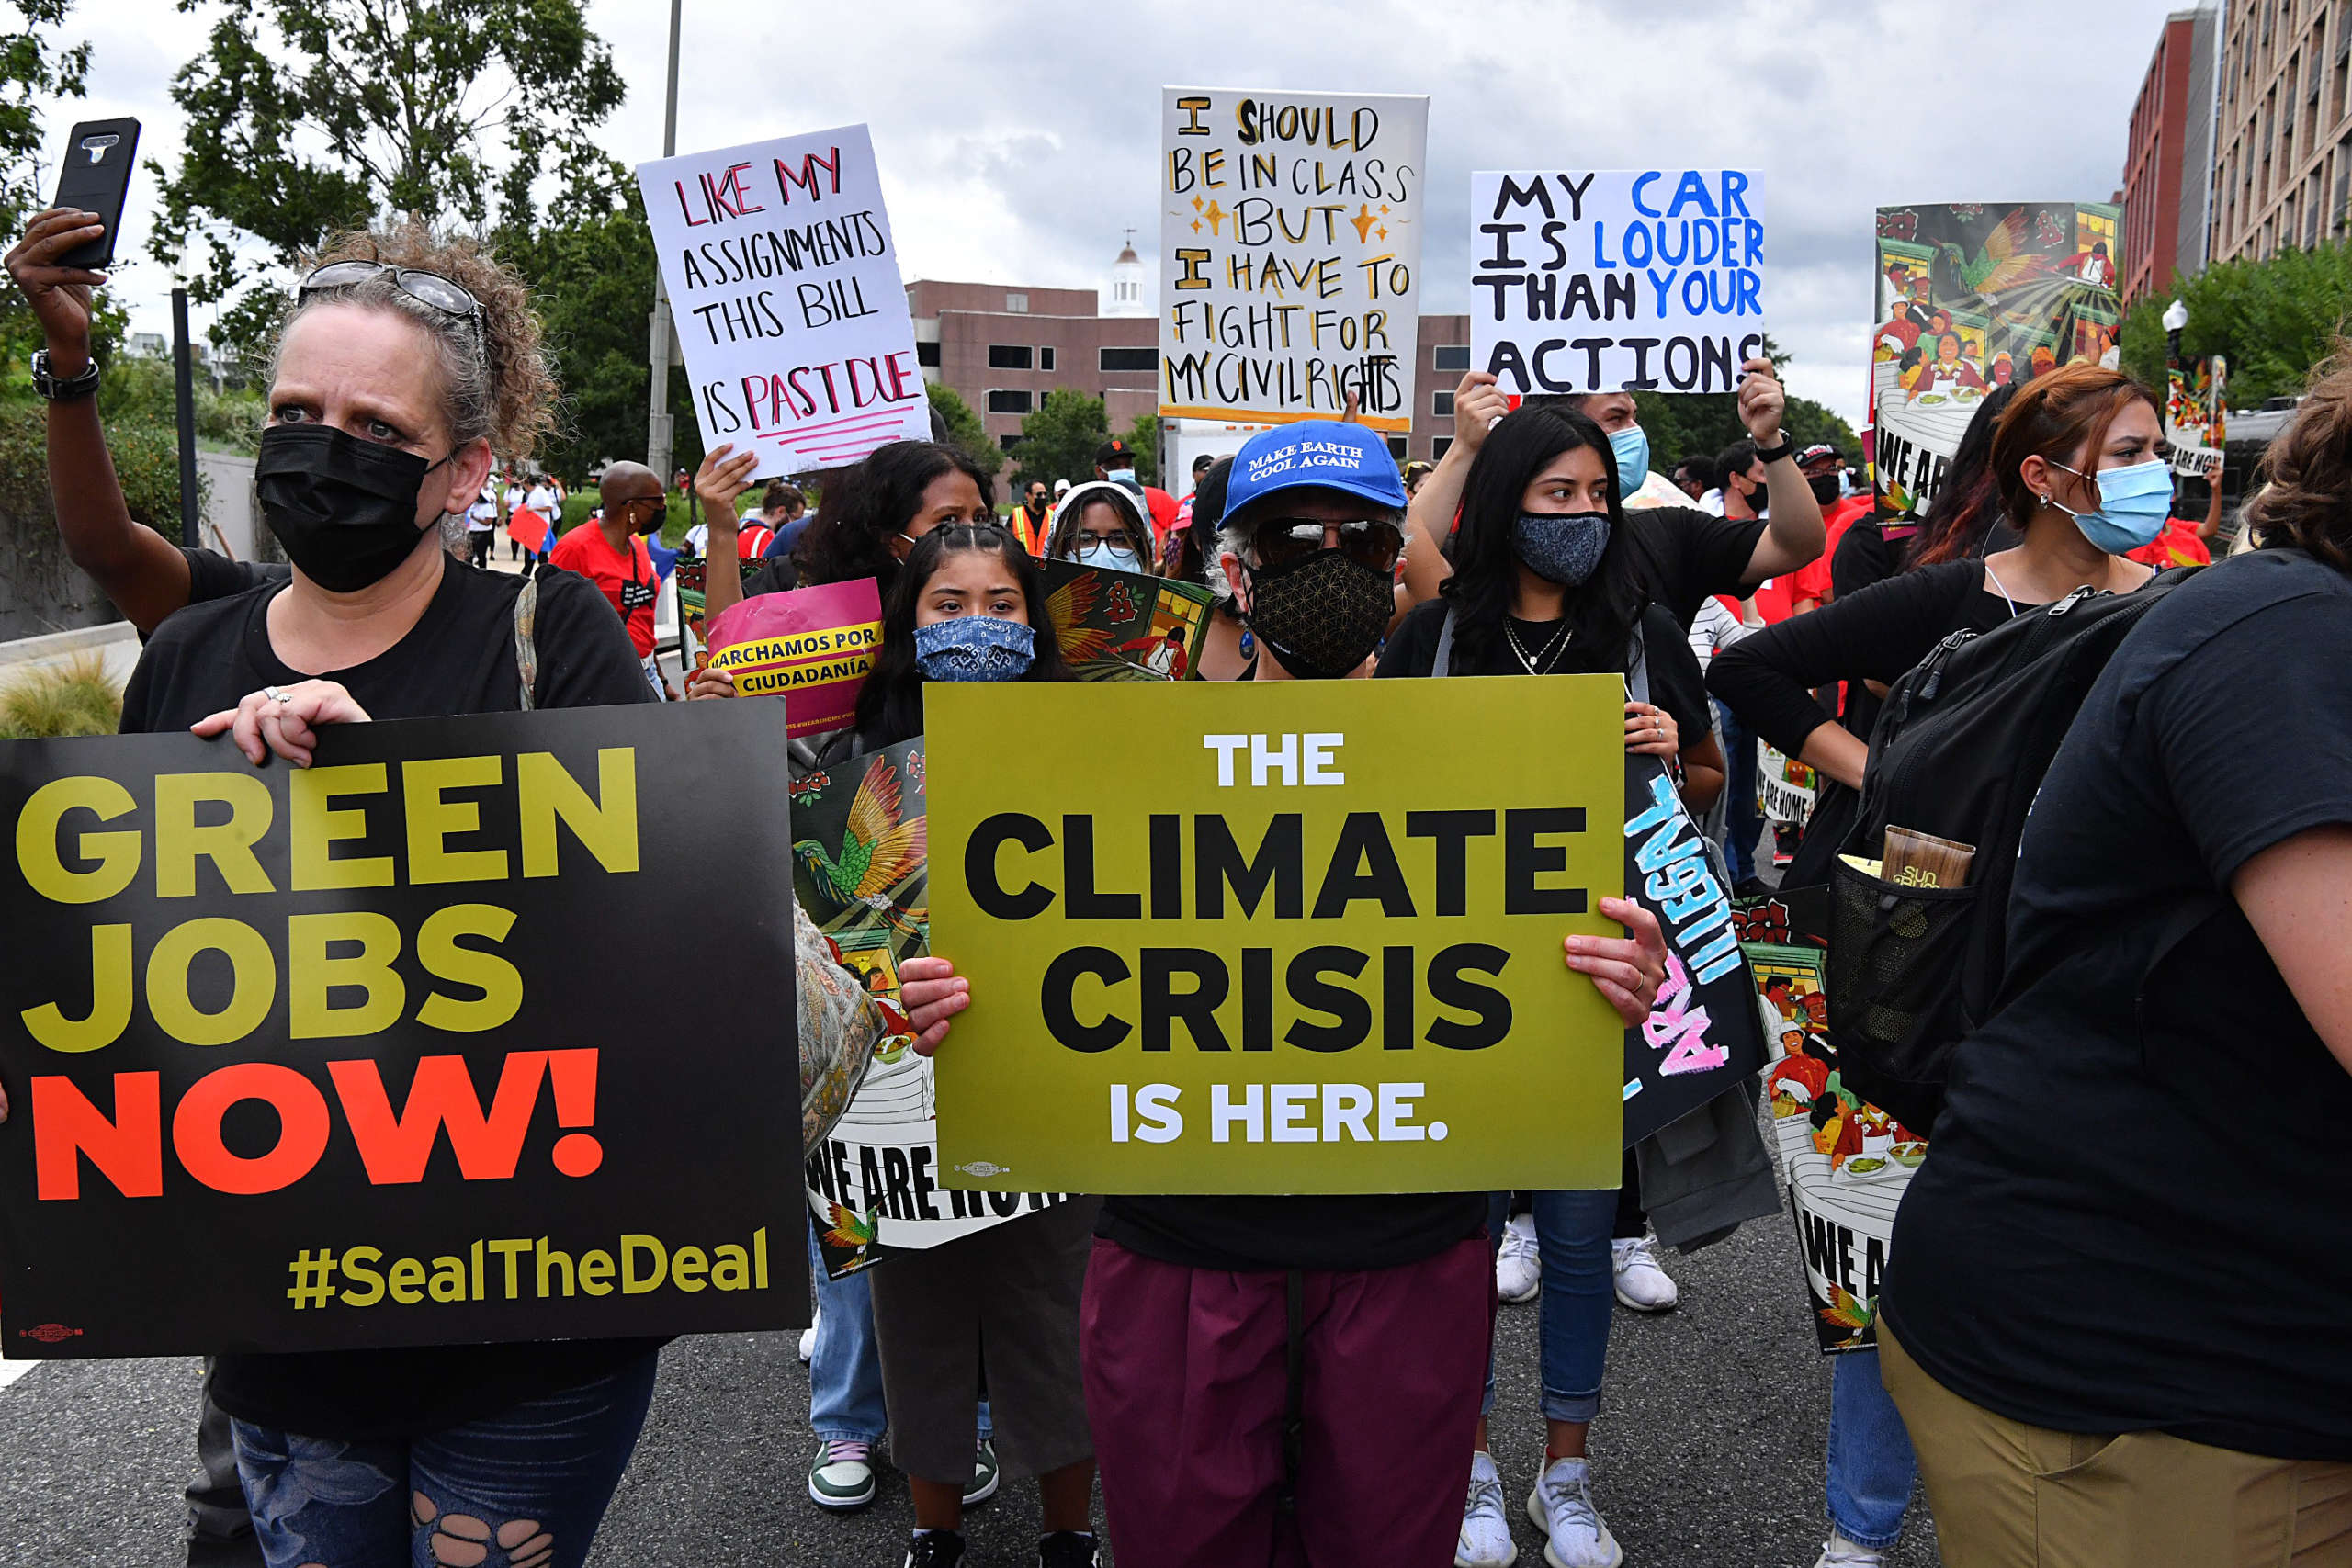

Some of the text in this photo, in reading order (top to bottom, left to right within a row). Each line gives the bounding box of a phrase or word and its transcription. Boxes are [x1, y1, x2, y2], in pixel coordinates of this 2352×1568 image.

[1177, 96, 1378, 152] I SHOULD
[674, 146, 841, 227] LIKE MY
[1169, 147, 1415, 203] BE IN CLASS
[1493, 170, 1750, 221] MY CAR
[683, 211, 885, 289] ASSIGNMENTS
[1233, 197, 1347, 246] BUT
[1480, 217, 1764, 271] IS LOUDER
[1174, 248, 1410, 299] I HAVE TO
[1472, 268, 1763, 321] THAN YOUR
[693, 276, 879, 345] THIS BILL
[1172, 300, 1392, 352] FIGHT FOR
[702, 351, 921, 434] IS PAST DUE
[1163, 350, 1402, 413] MY CIVIL RIGHTS
[1249, 441, 1363, 472] MAKE EARTH
[1250, 455, 1360, 481] COOL AGAIN
[1879, 427, 1950, 501] WE AR
[835, 629, 876, 648] POR
[742, 658, 871, 691] CIUDADANÍA
[1203, 732, 1344, 787] THE
[16, 746, 639, 904] GREEN
[1766, 779, 1779, 811] ARE
[1779, 789, 1807, 822] HOME
[963, 807, 1588, 921] CLIMATE
[20, 903, 524, 1054] JOBS
[1040, 942, 1512, 1053] CRISIS
[31, 1048, 603, 1201] NOW!
[1110, 1081, 1448, 1143] IS HERE.
[805, 1140, 940, 1220] WE ARE
[286, 1226, 769, 1310] #SealTheDeal
[1803, 1208, 1858, 1297] WE
